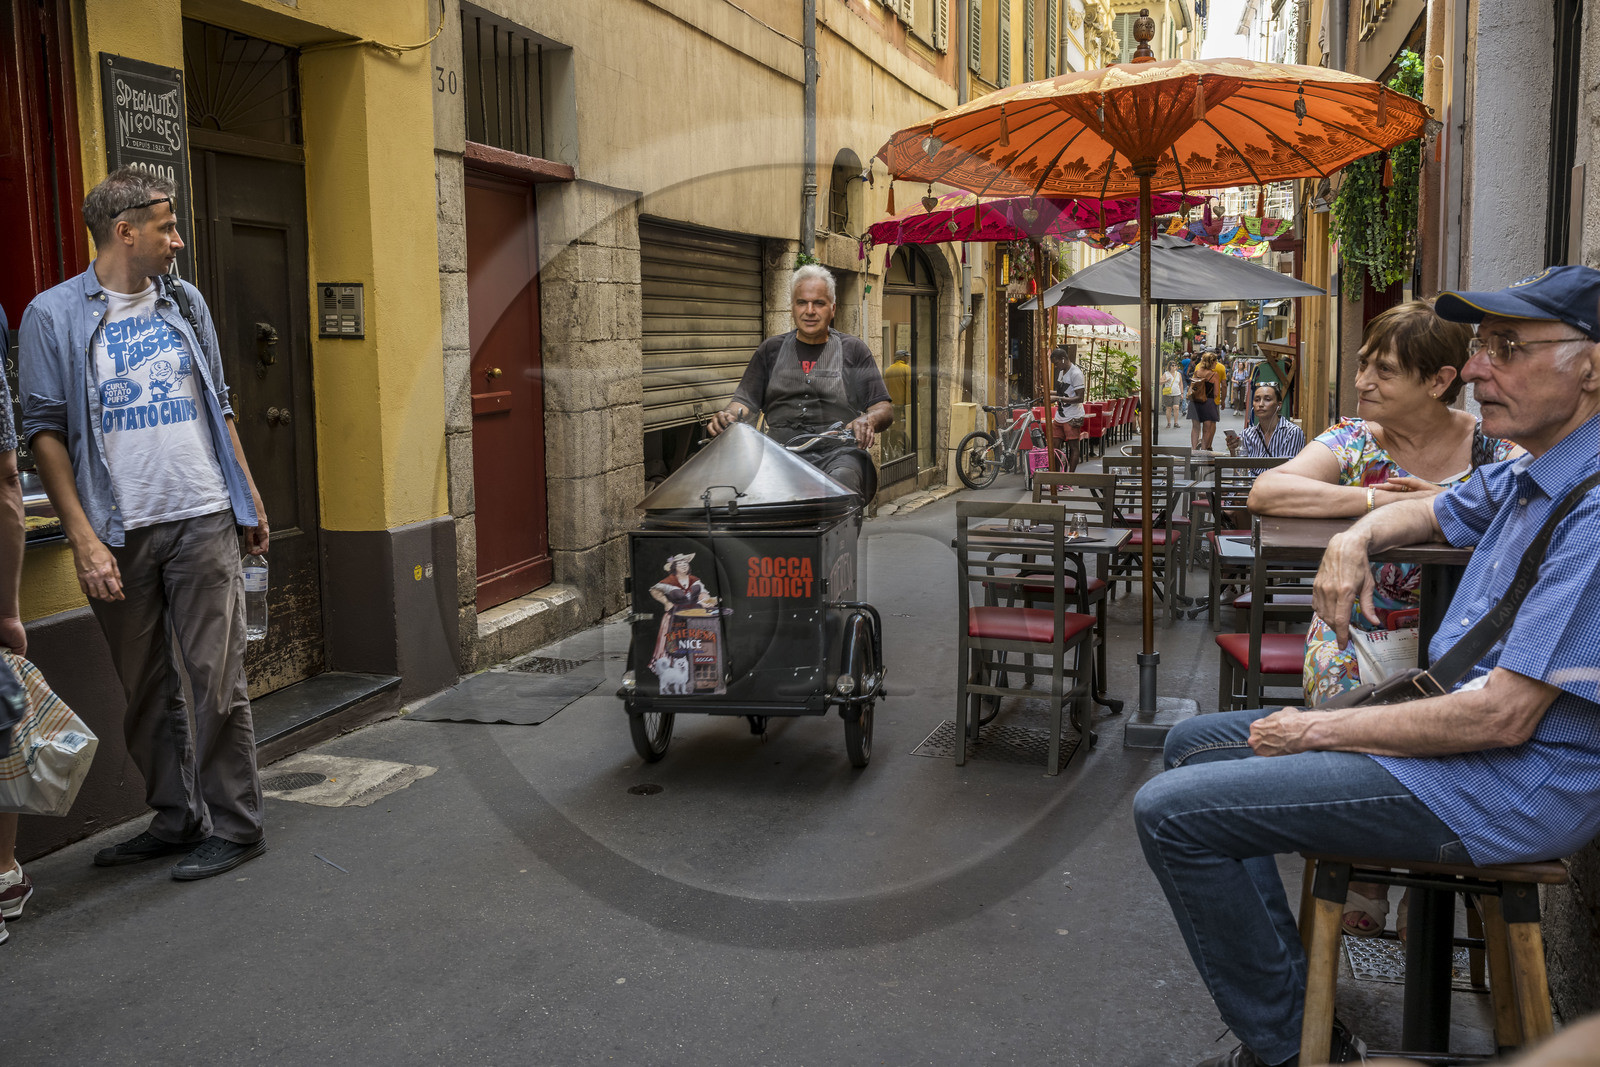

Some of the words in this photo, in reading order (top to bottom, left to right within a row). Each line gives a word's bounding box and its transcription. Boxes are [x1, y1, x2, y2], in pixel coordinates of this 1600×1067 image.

[435, 65, 457, 95] 30
[107, 327, 185, 377] Taste
[104, 388, 132, 397] POTATO
[105, 381, 128, 390] CURLY
[107, 395, 129, 404] PUFFS
[102, 404, 158, 434] OTATO
[160, 399, 198, 425] CHIPS
[747, 557, 813, 578] SOCCA
[746, 577, 814, 598] ADDICT
[678, 639, 702, 649] NICE
